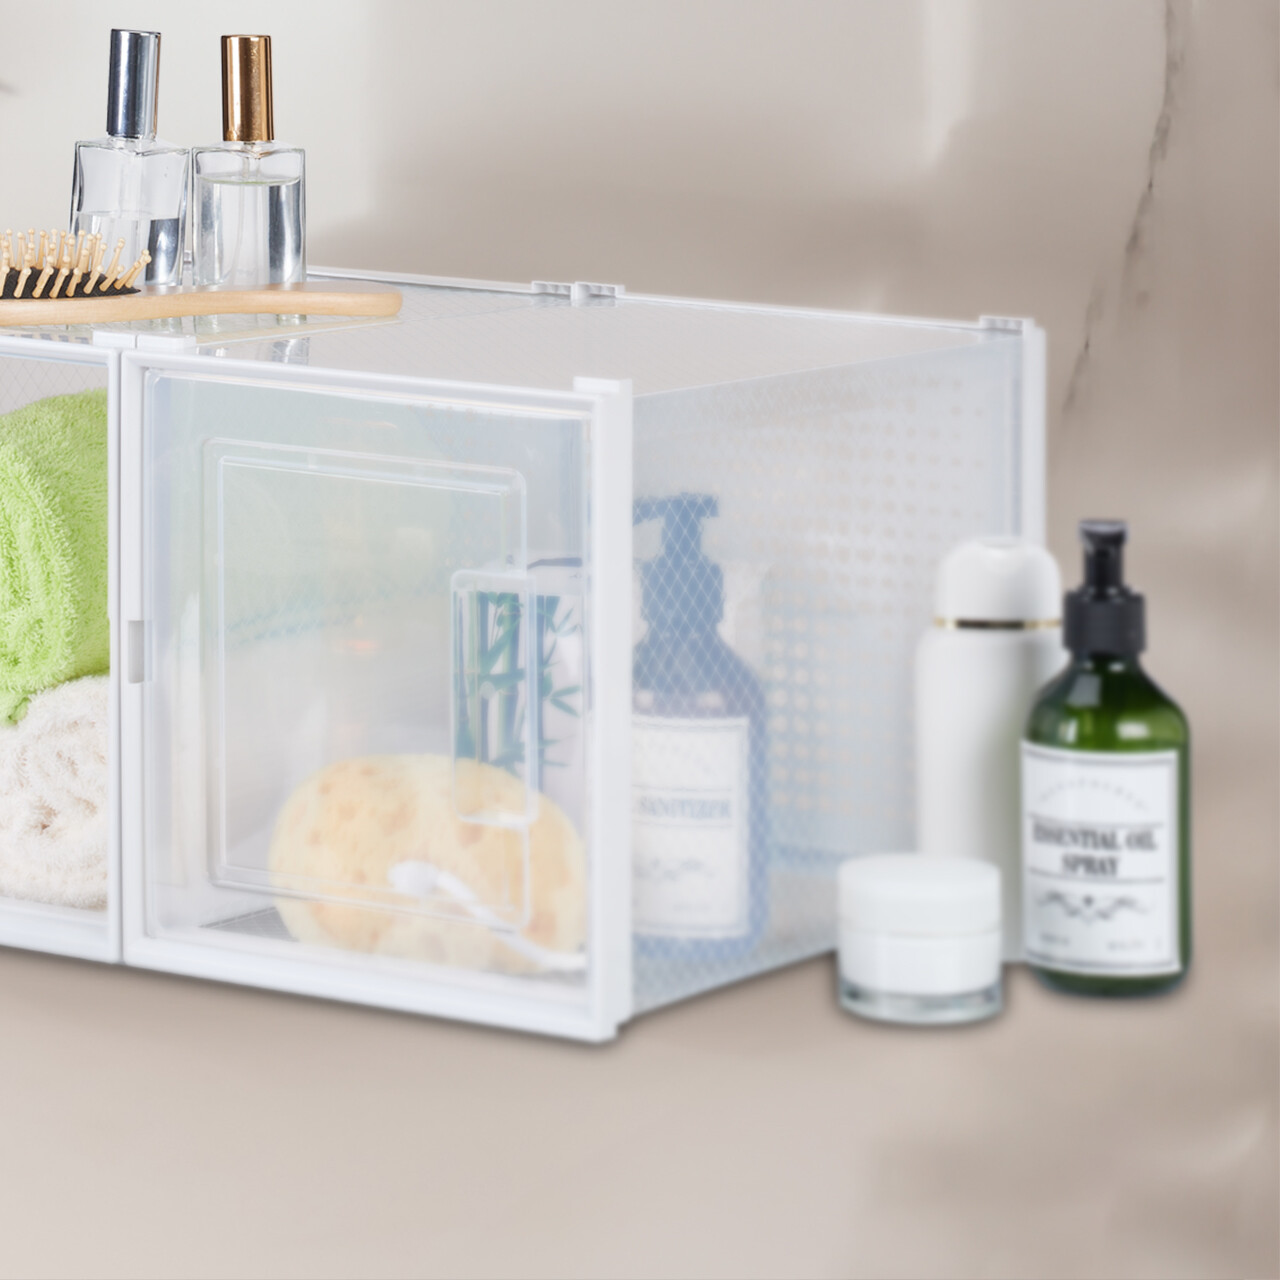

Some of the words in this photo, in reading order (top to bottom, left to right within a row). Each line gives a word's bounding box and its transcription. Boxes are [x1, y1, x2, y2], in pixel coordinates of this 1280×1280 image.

[639, 796, 732, 819] SANITIZER
[1033, 823, 1120, 851] ESSENTIAL
[1126, 830, 1157, 851] OIL
[1063, 854, 1119, 876] SPRAY
